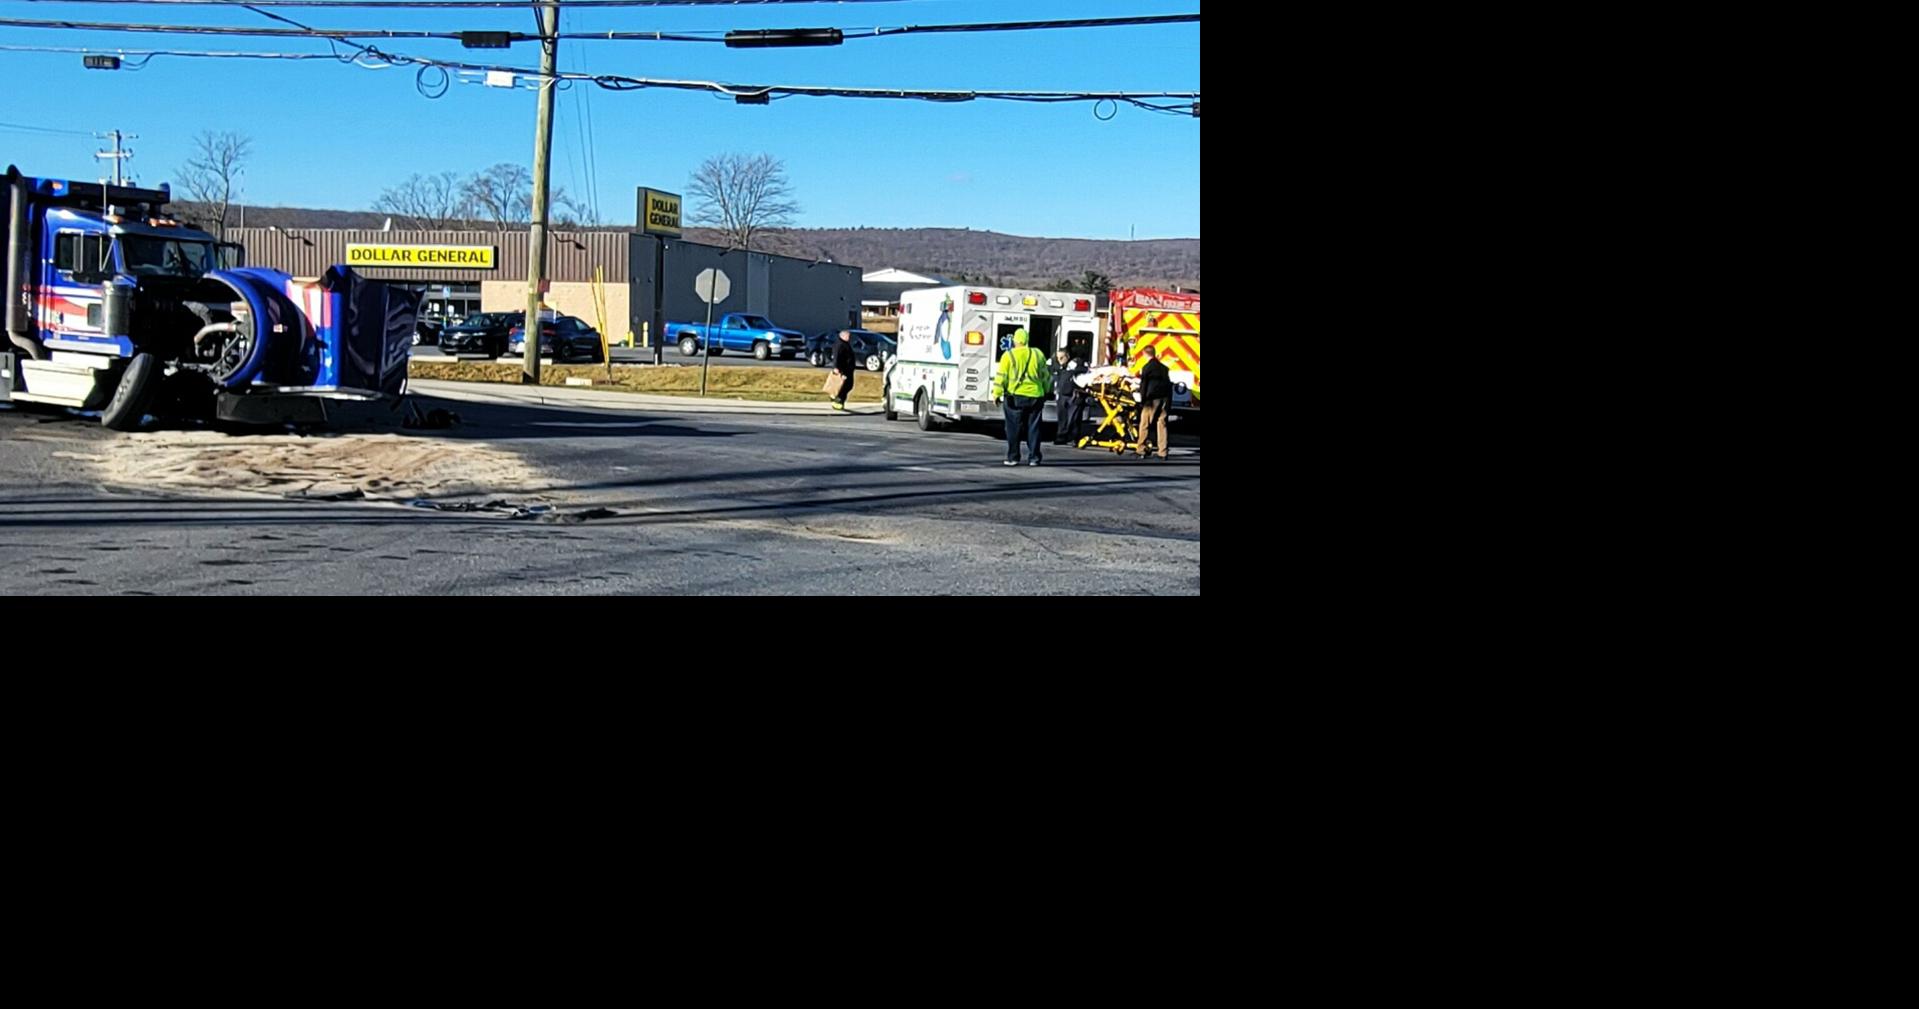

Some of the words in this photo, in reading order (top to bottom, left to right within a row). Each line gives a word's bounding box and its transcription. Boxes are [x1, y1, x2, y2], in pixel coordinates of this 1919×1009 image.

[652, 198, 678, 214] DOLLAR
[650, 212, 680, 228] GENERAL
[351, 248, 412, 262] DOLLAR
[417, 249, 489, 263] GENERAL
